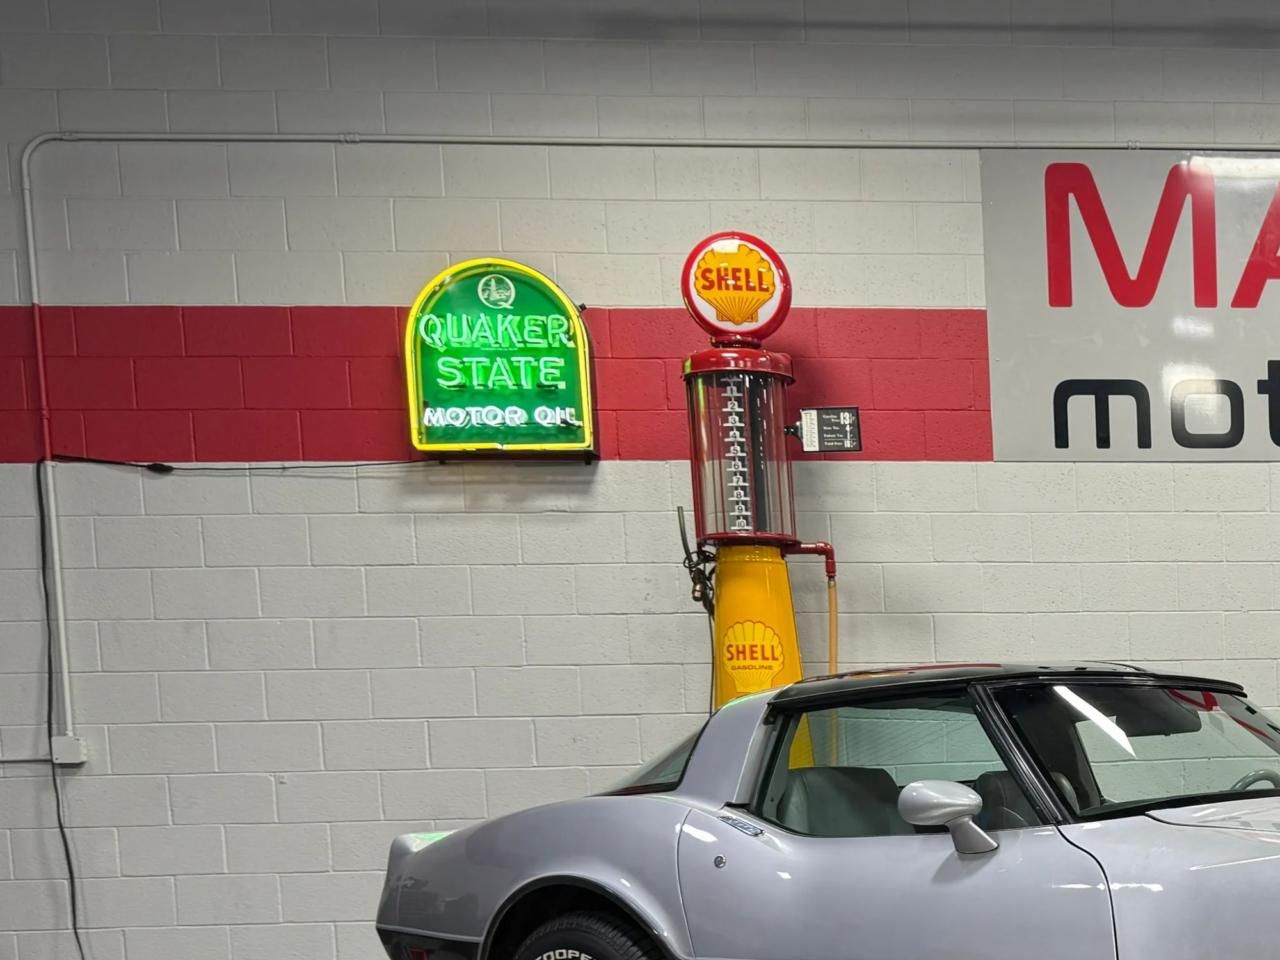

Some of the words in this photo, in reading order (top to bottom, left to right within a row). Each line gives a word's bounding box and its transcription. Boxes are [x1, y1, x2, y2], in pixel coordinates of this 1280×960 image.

[701, 268, 769, 292] SHELL
[419, 313, 576, 351] QUAKER
[437, 357, 566, 389] STATE
[423, 405, 528, 427] MOTOR
[533, 405, 583, 427] OIL
[726, 644, 779, 661] SHELL
